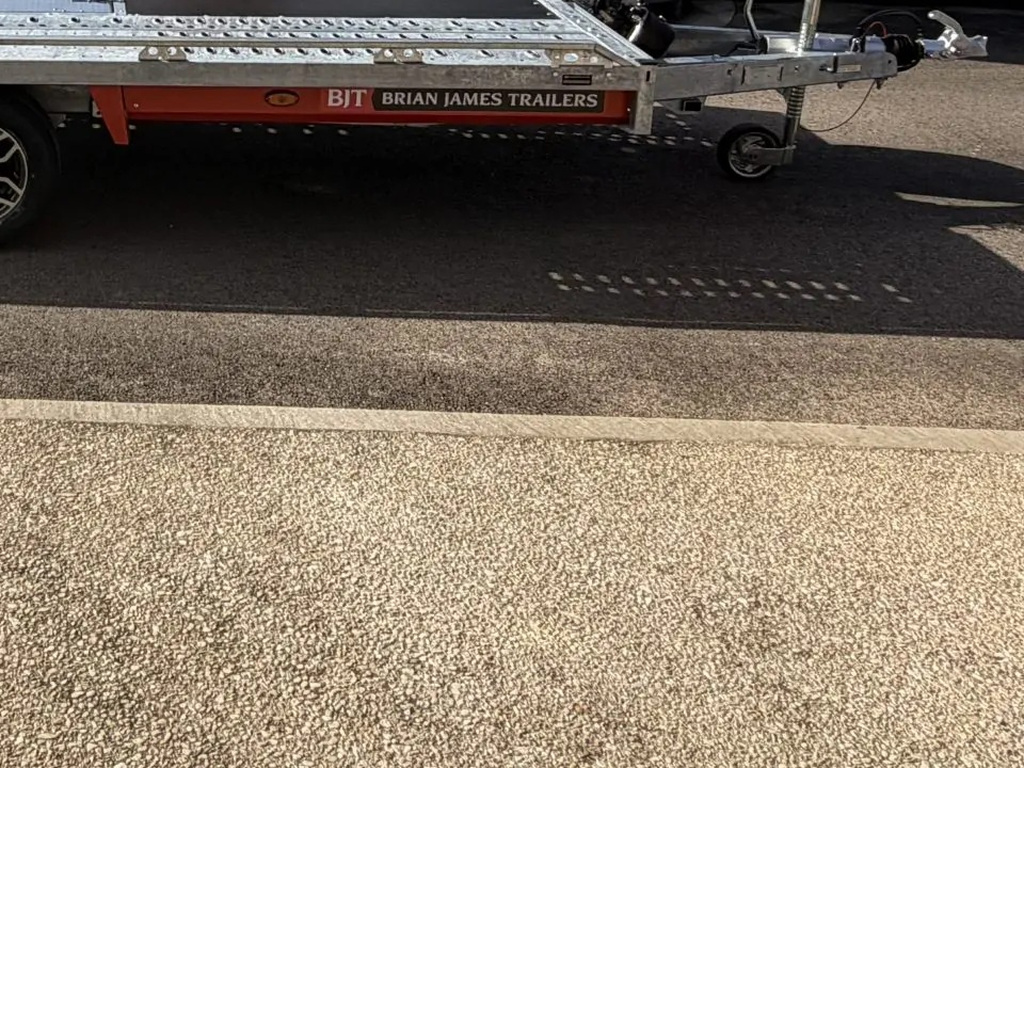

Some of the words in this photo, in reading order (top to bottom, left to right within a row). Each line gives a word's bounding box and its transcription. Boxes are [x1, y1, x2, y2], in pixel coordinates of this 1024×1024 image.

[327, 88, 368, 109] BJT
[381, 91, 438, 106] BRIAN
[444, 92, 503, 107] JAMES
[508, 93, 599, 108] TRAILERS
